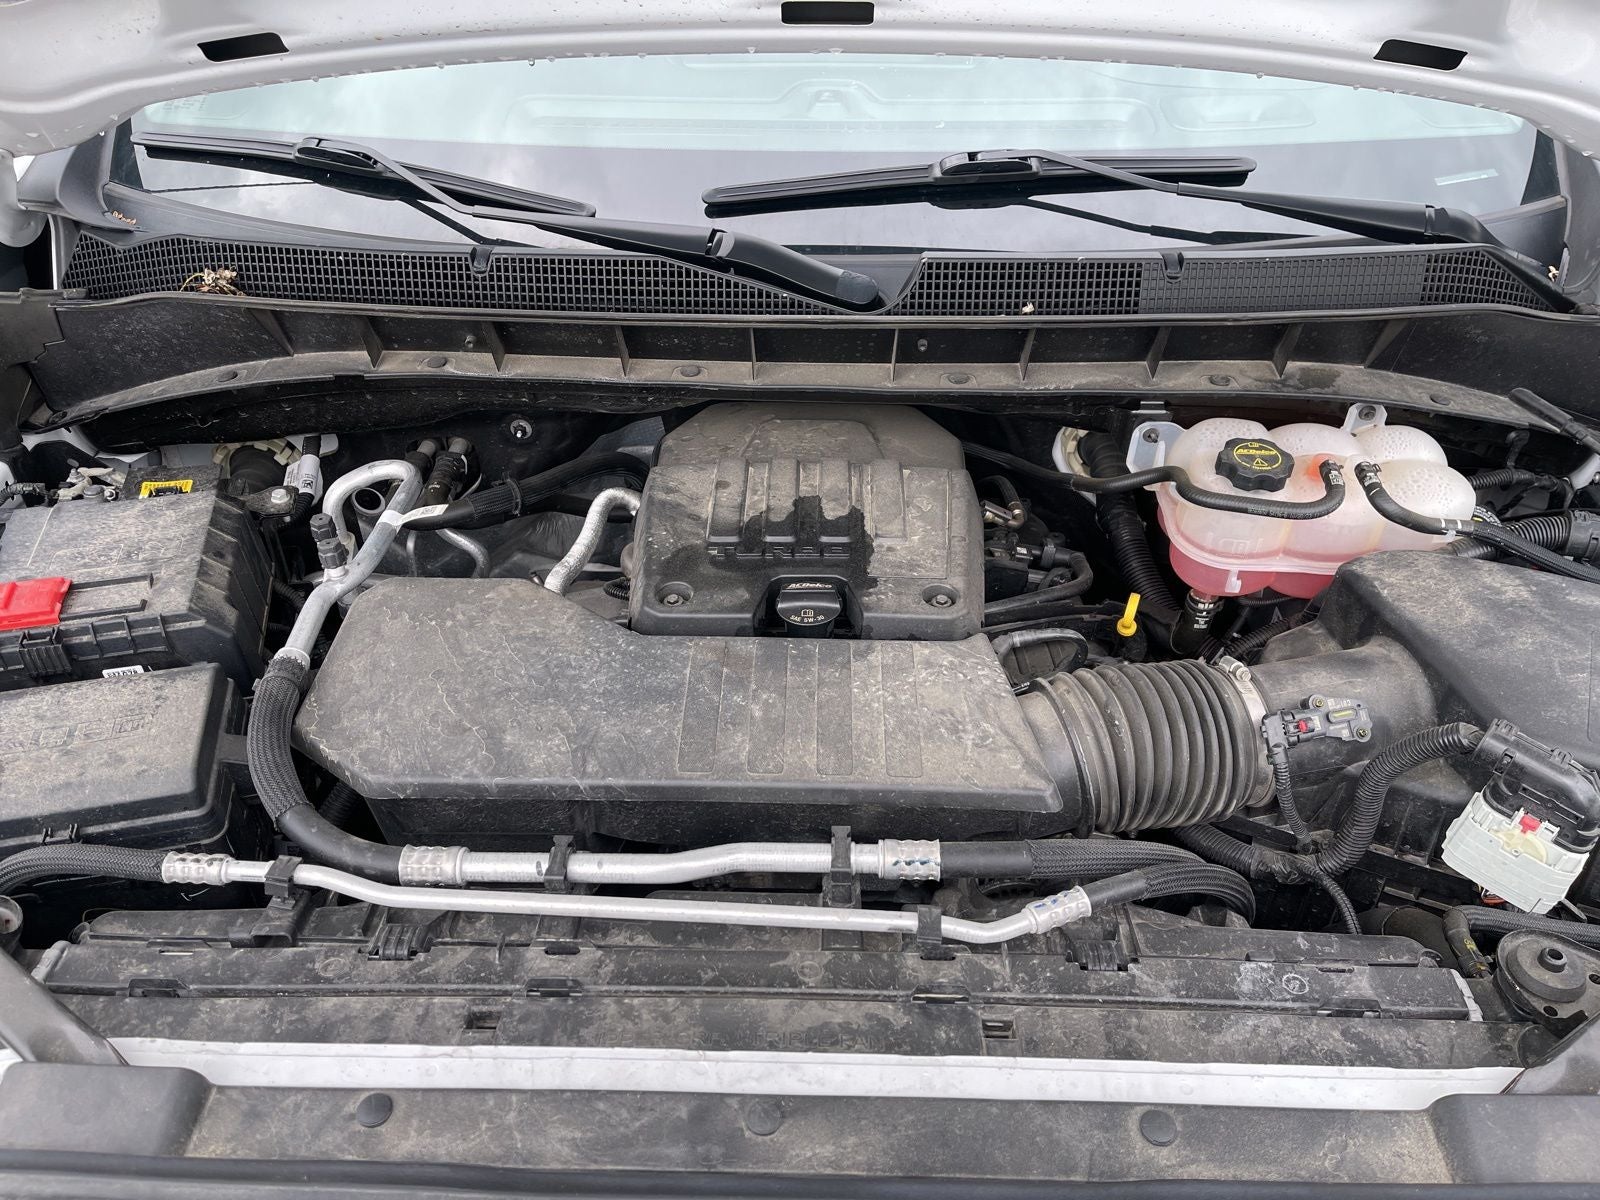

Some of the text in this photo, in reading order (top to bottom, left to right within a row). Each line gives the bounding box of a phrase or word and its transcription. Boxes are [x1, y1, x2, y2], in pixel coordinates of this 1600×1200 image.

[707, 545, 850, 559] TURBO
[786, 582, 833, 590] ACDelco
[790, 614, 801, 622] SAE
